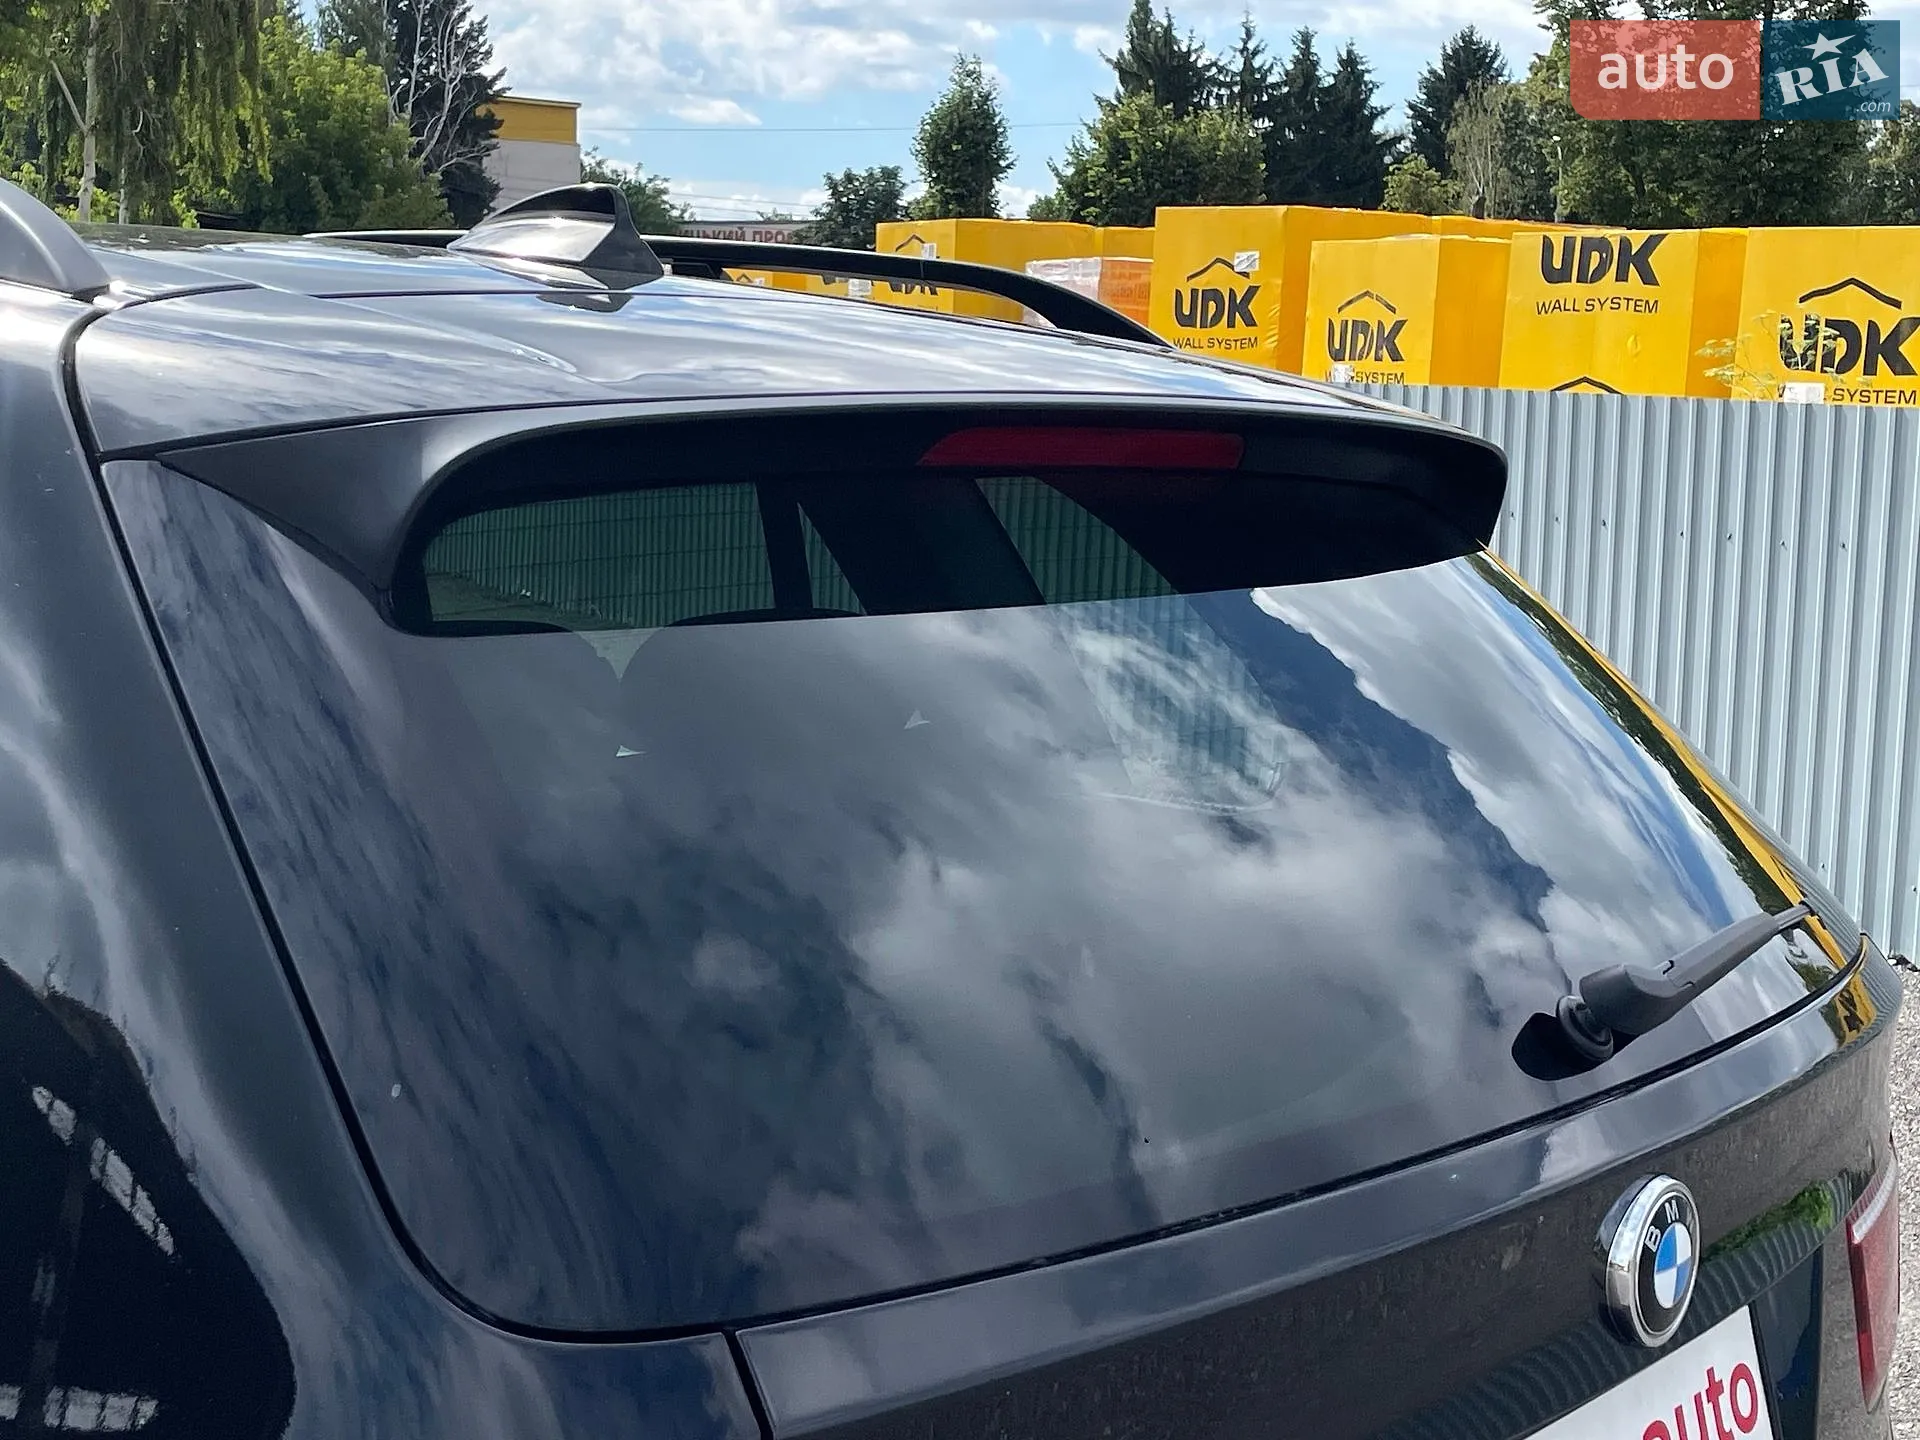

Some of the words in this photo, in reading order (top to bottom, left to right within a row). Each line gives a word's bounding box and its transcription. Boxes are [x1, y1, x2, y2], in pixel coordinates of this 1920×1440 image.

[1541, 234, 1668, 287] UDK
[1174, 285, 1261, 328] UDK
[1536, 298, 1580, 315] WALL
[1585, 296, 1659, 314] SYSTEM
[1173, 337, 1203, 349] WALL
[1207, 336, 1258, 350] SYSTEM
[1327, 317, 1408, 361] UDK
[1780, 314, 1920, 376] UDK
[1355, 371, 1405, 385] SYSTEM
[1832, 388, 1917, 405] SYSTEM
